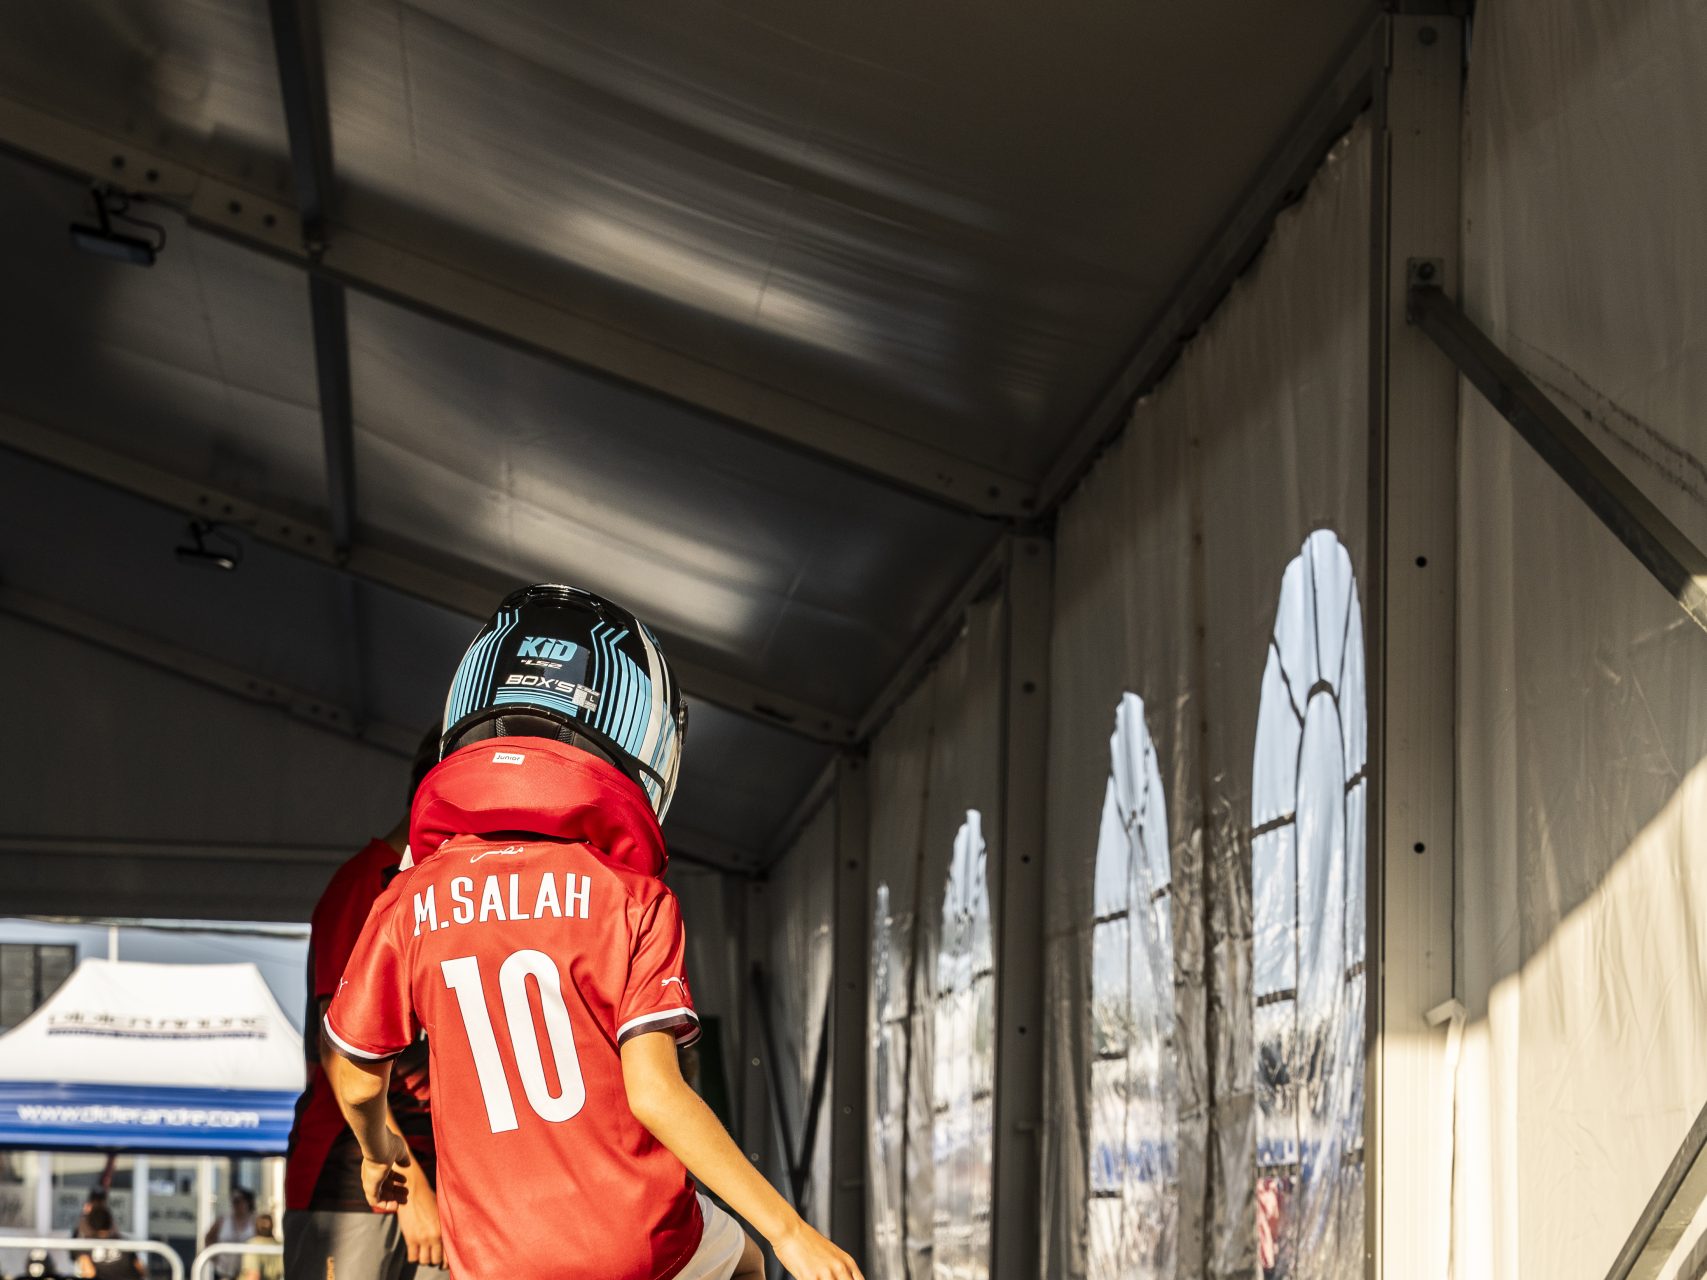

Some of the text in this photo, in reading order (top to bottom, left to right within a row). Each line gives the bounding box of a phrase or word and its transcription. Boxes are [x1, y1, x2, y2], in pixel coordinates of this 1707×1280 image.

[505, 674, 576, 693] BOX'S
[413, 872, 591, 937] M.SALAH
[440, 949, 586, 1134] 10
